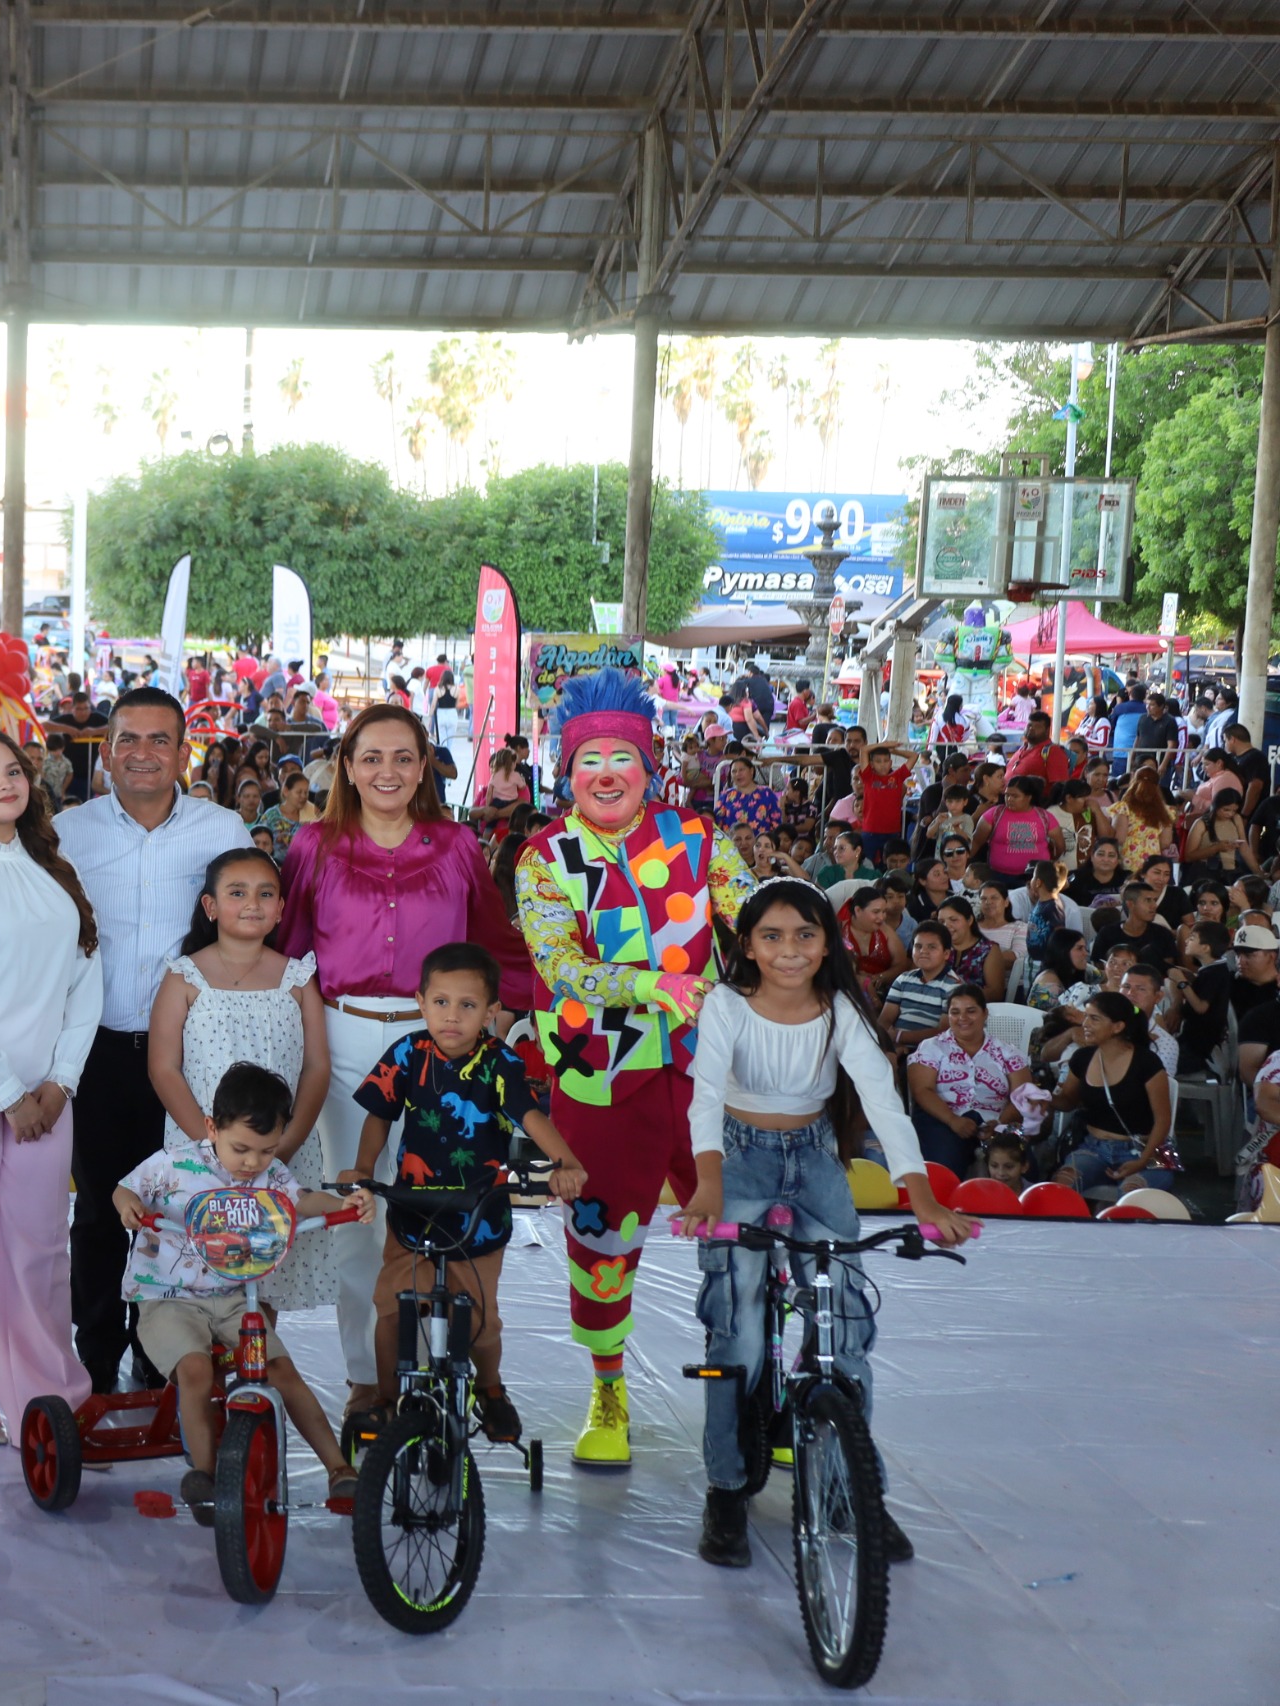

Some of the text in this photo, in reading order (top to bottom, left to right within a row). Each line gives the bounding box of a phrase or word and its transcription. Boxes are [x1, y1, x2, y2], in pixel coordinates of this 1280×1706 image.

[703, 566, 815, 595] Pymasa
[536, 643, 636, 673] Algodón
[538, 673, 556, 684] de
[208, 1197, 258, 1212] BLAZER
[226, 1209, 260, 1227] RUN
